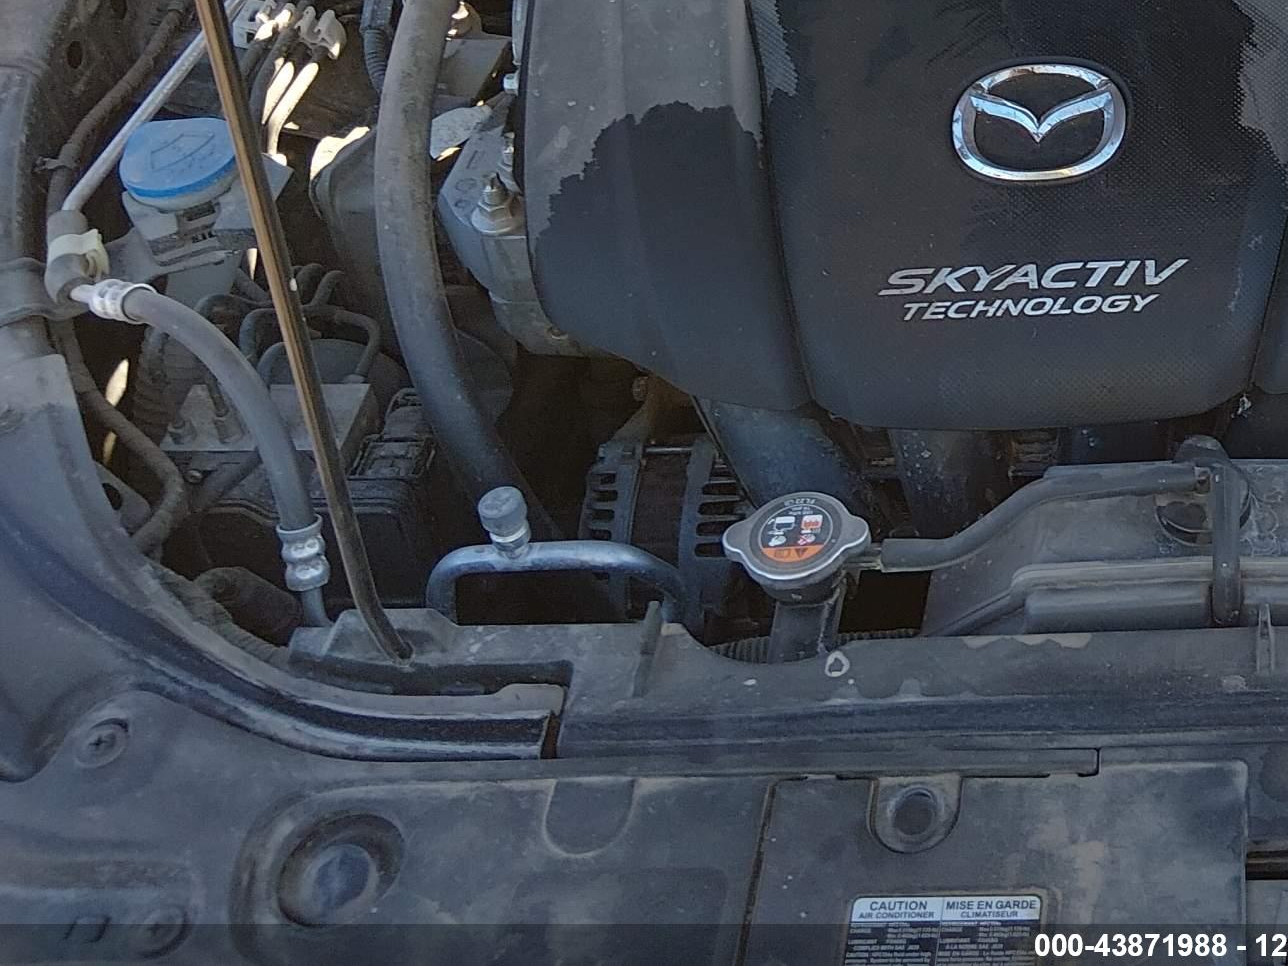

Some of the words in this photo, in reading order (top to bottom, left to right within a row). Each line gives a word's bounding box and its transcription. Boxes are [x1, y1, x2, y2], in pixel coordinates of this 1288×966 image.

[878, 258, 1190, 295] SKYACTIV
[903, 294, 1160, 321] TECHNOLOGY
[869, 900, 928, 911] CAUTION
[945, 900, 975, 910] MISE
[976, 900, 993, 910] EN
[995, 899, 1037, 910] GARDE
[875, 911, 935, 919] CONDITIONER
[960, 911, 1019, 919] CLIMATISEUR
